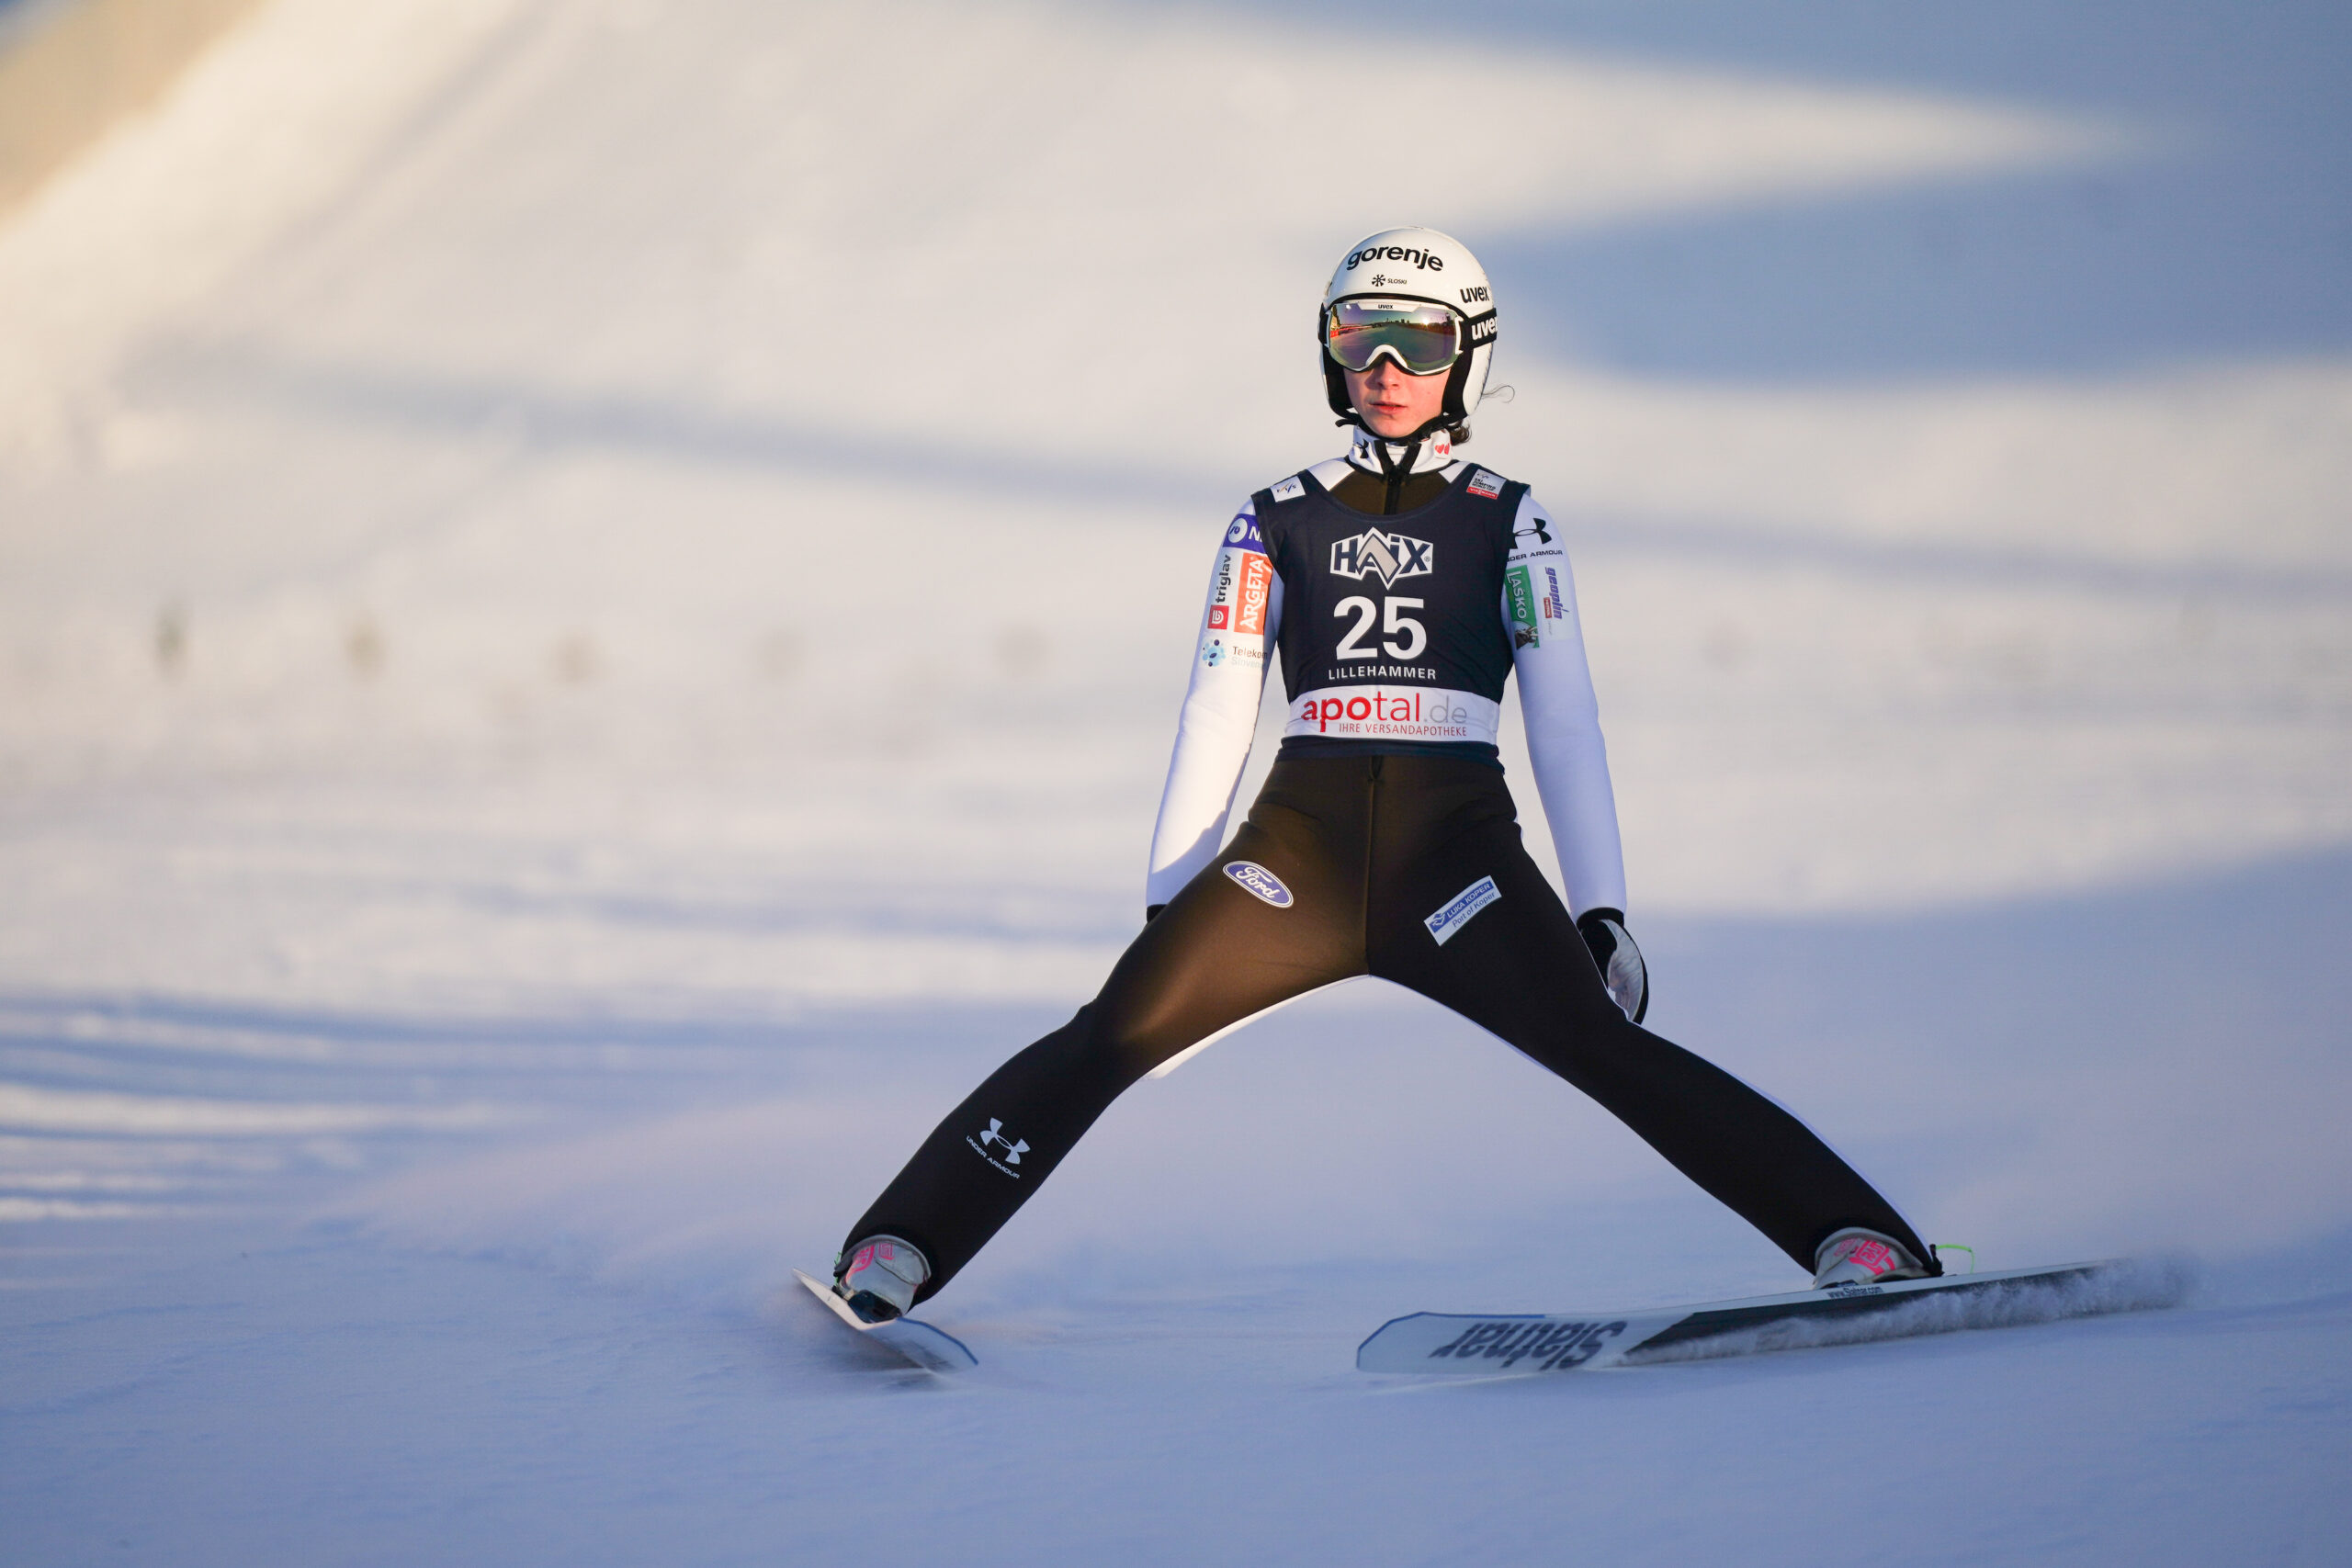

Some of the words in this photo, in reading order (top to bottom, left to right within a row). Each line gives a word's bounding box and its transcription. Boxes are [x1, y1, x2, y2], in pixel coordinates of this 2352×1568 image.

[1347, 246, 1443, 271] gorenje
[1460, 287, 1489, 303] uvex
[1216, 554, 1231, 603] triglav
[1239, 559, 1265, 630] ARGETA
[1544, 567, 1569, 619] geoplin
[1333, 595, 1427, 660] 25
[1328, 665, 1436, 680] LILLEHAMMER
[1301, 691, 1467, 733] apotal.de
[1339, 723, 1361, 733] IHRE
[1365, 724, 1467, 736] VERSANDAPOTHEKE
[1236, 866, 1280, 898] Ford
[1446, 902, 1465, 919] LUKA
[1464, 883, 1490, 903] KOPER
[1473, 892, 1495, 909] Koper
[967, 1135, 987, 1157] UNDER
[987, 1157, 1020, 1179] ARMOUR
[1428, 1321, 1628, 1371] Slatnar
